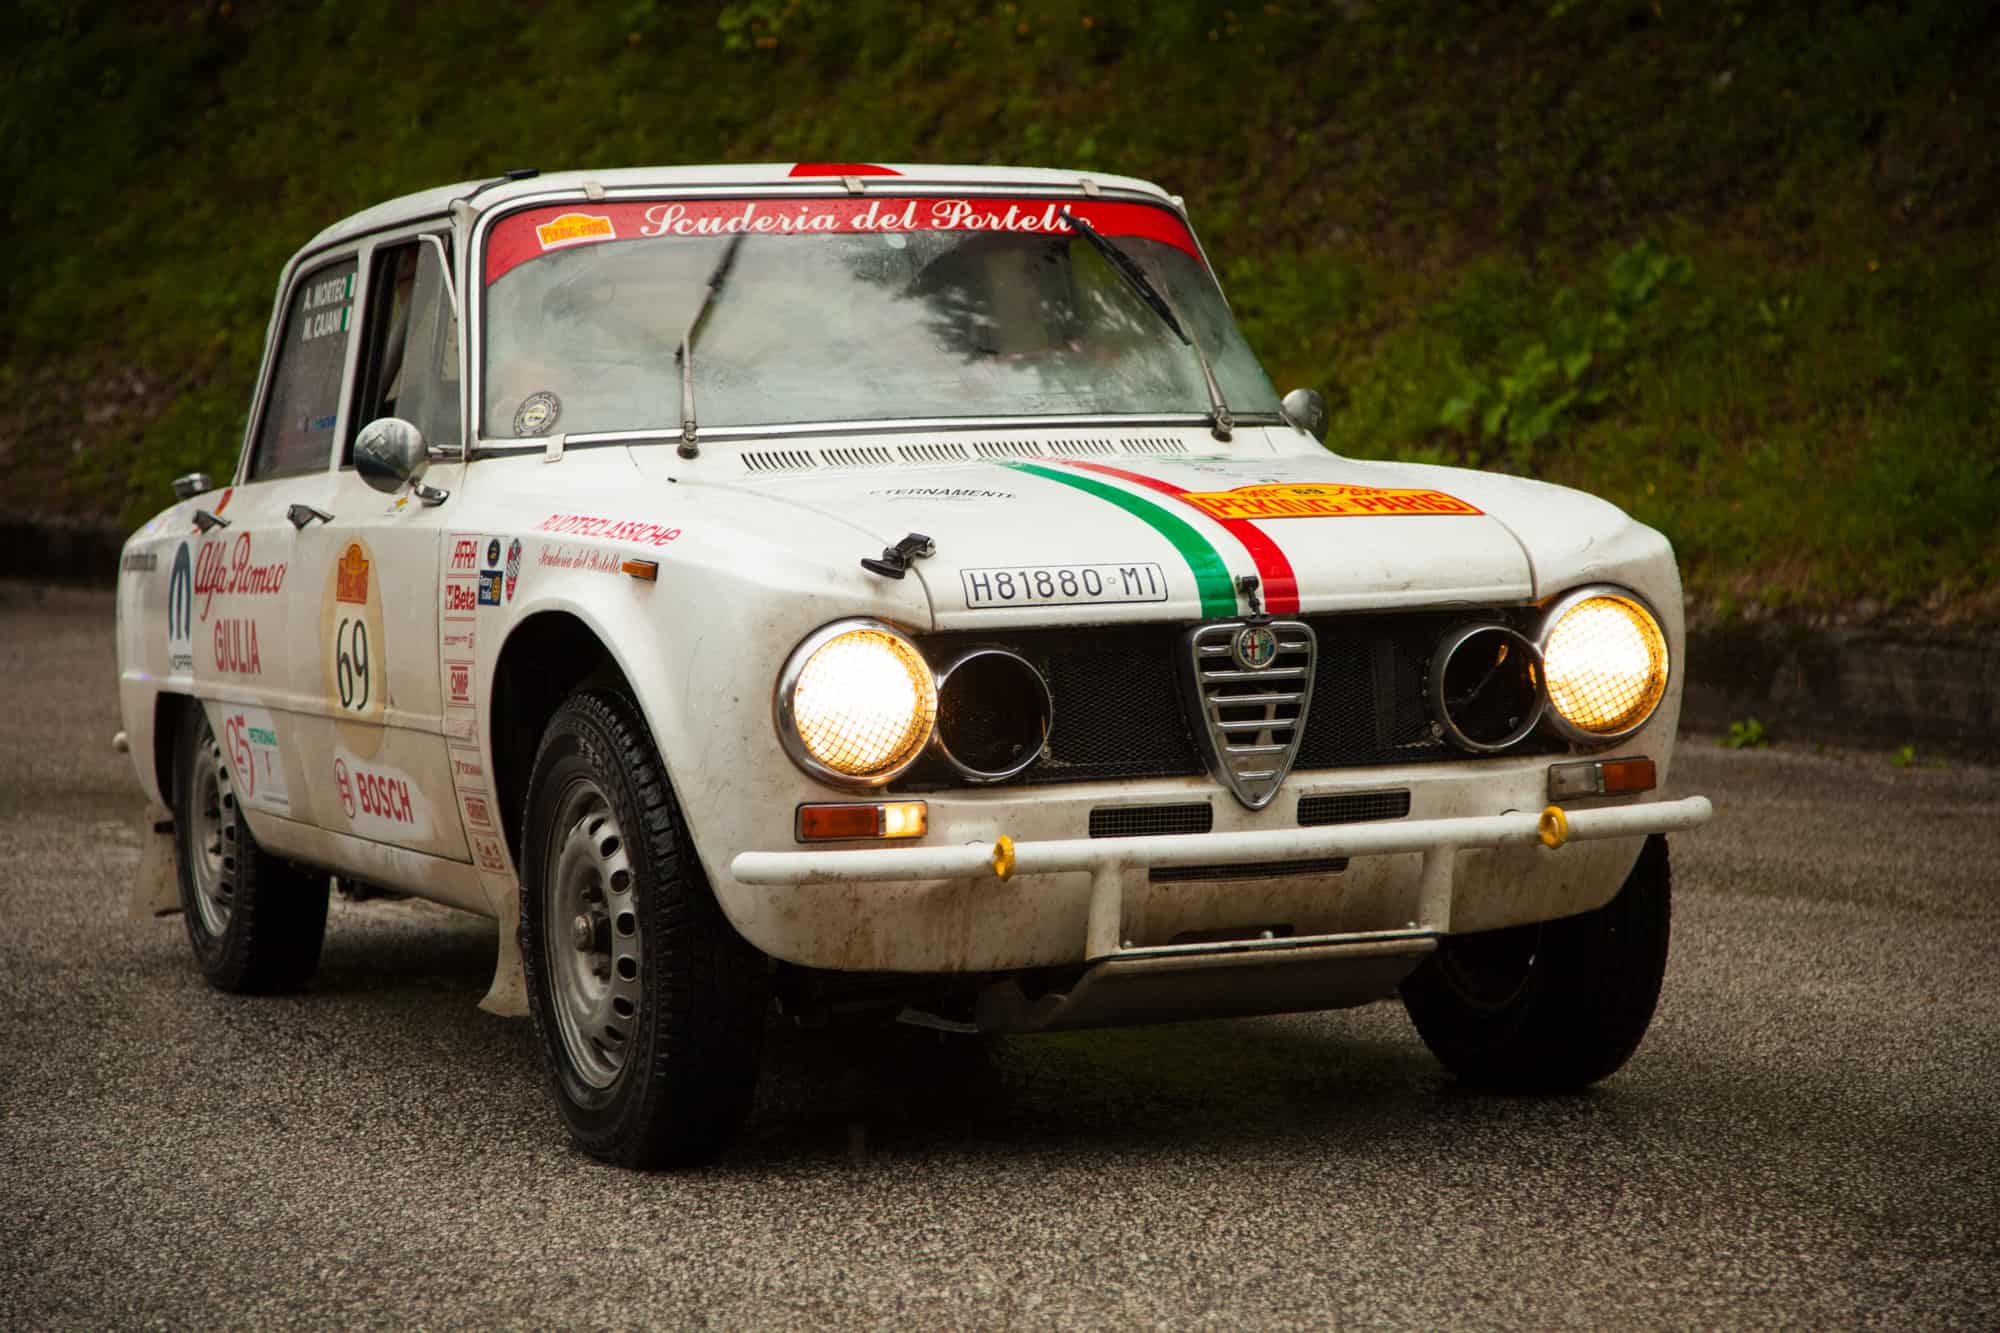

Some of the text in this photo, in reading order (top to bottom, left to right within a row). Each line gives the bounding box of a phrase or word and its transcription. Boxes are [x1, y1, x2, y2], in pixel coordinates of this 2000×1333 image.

[640, 202, 840, 237] Scuderia
[852, 200, 918, 231] del
[194, 541, 227, 622] Alfa
[225, 531, 288, 595] Romeo
[454, 584, 475, 611] Beta
[970, 567, 1157, 601] H81880 MI
[214, 619, 262, 674] GIULIA
[336, 618, 369, 710] 69
[355, 772, 415, 824] BOSCH
